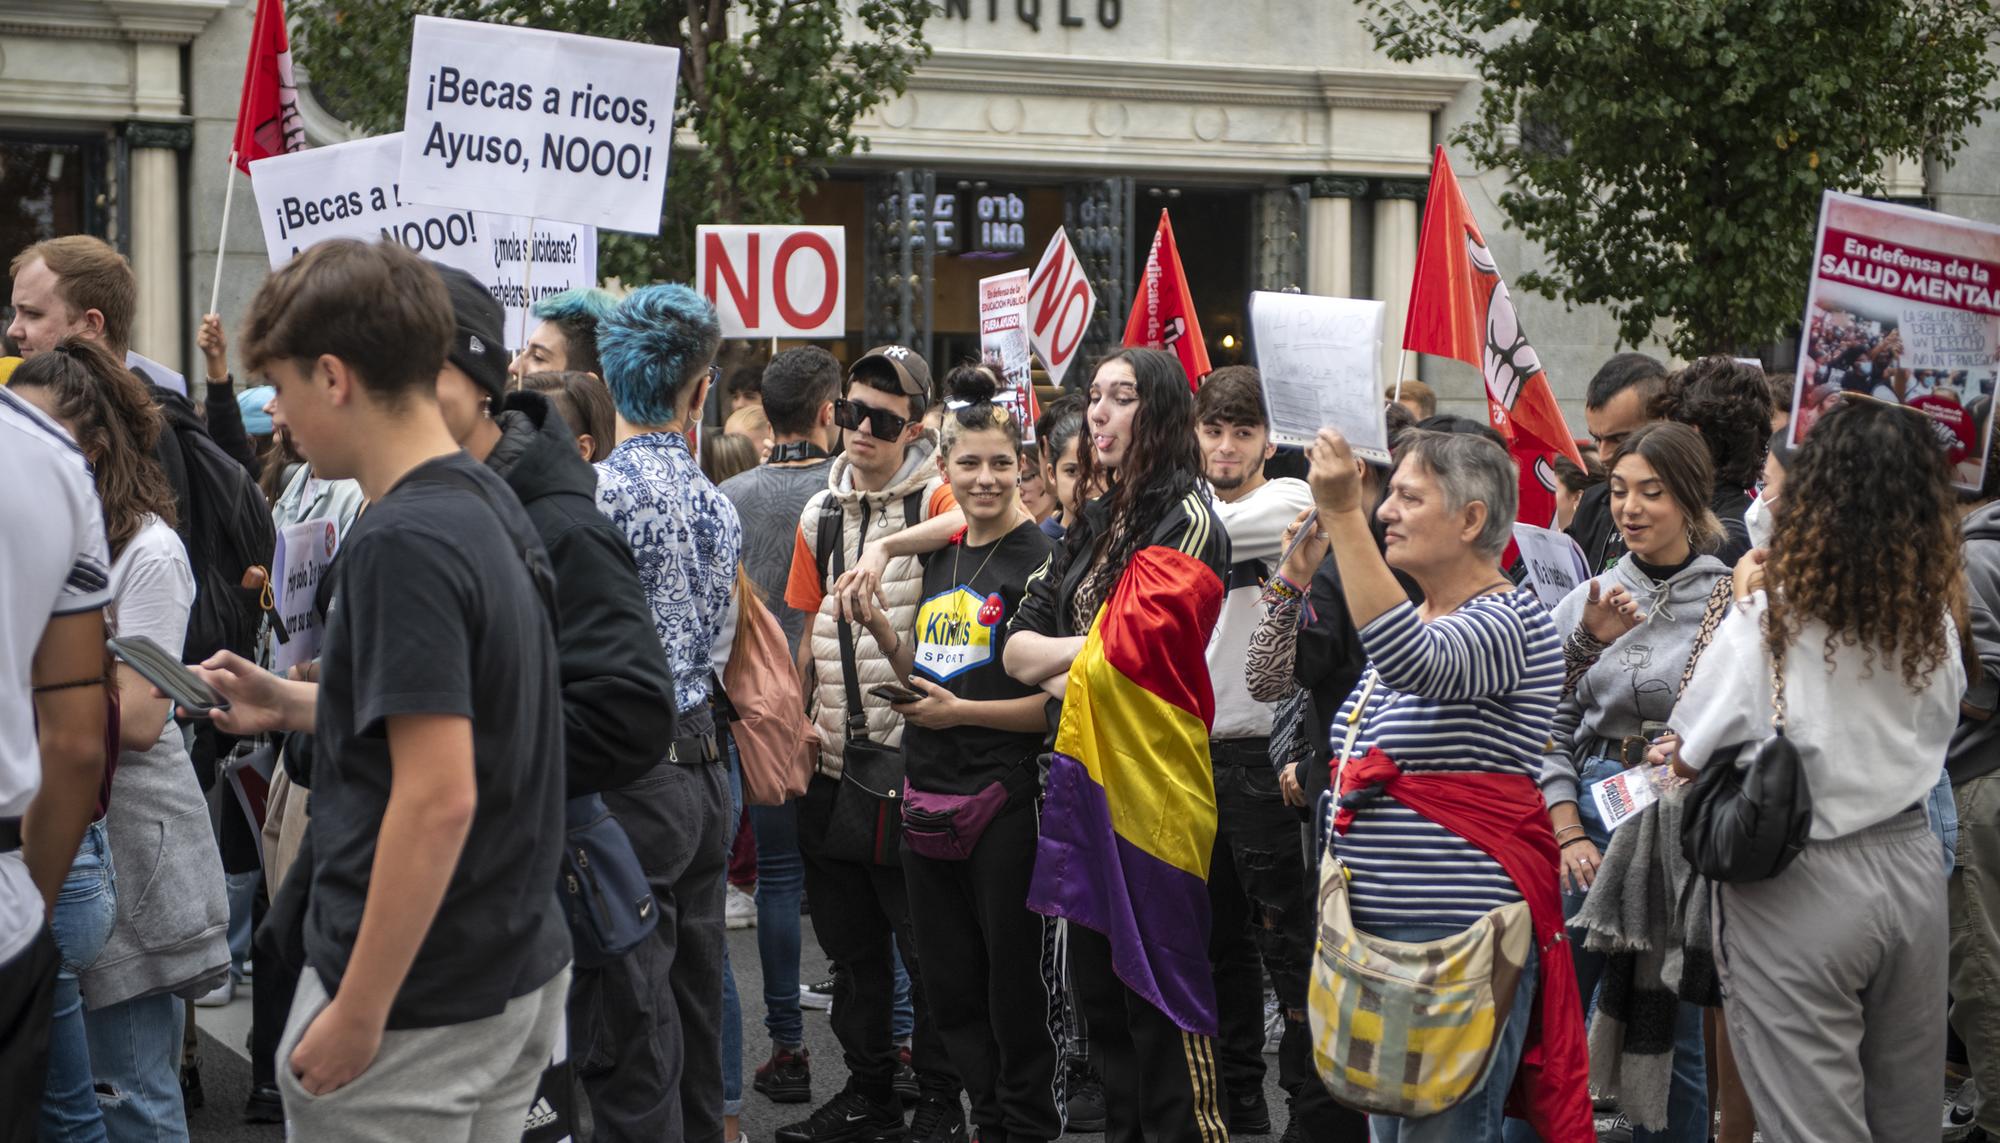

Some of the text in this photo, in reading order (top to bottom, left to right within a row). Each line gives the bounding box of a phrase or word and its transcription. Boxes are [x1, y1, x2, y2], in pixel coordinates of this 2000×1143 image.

[945, 0, 1122, 32] NIQLO
[425, 66, 657, 133] ¡Becas a ricos,
[423, 121, 652, 182] Ayuso, NOOO!
[276, 190, 363, 240] ¡Becas
[369, 186, 387, 211] a
[494, 231, 521, 269] ¿mola
[1844, 237, 1990, 284] En defensa de la
[704, 231, 840, 330] NO
[1028, 238, 1089, 367] NO
[1820, 254, 2000, 311] SALUD MENTAL
[924, 651, 965, 664] SPORT
